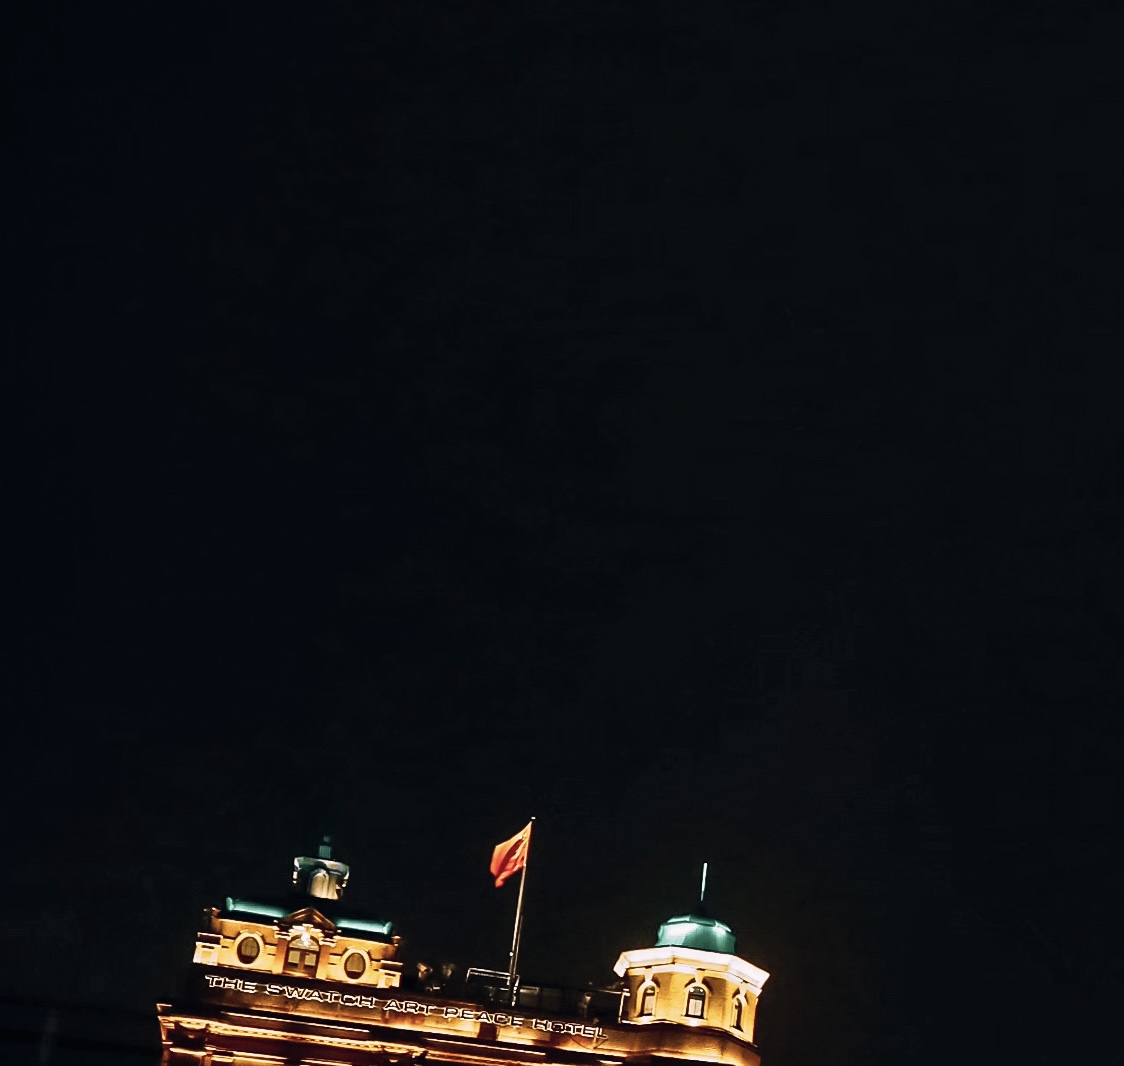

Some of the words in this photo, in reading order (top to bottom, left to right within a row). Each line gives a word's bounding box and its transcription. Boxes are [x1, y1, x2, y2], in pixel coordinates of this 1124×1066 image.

[205, 975, 258, 994] THE
[265, 984, 378, 1009] SWATCH
[382, 999, 437, 1015] ART
[444, 1007, 524, 1027] PEACE
[532, 1018, 609, 1039] HOTEL
